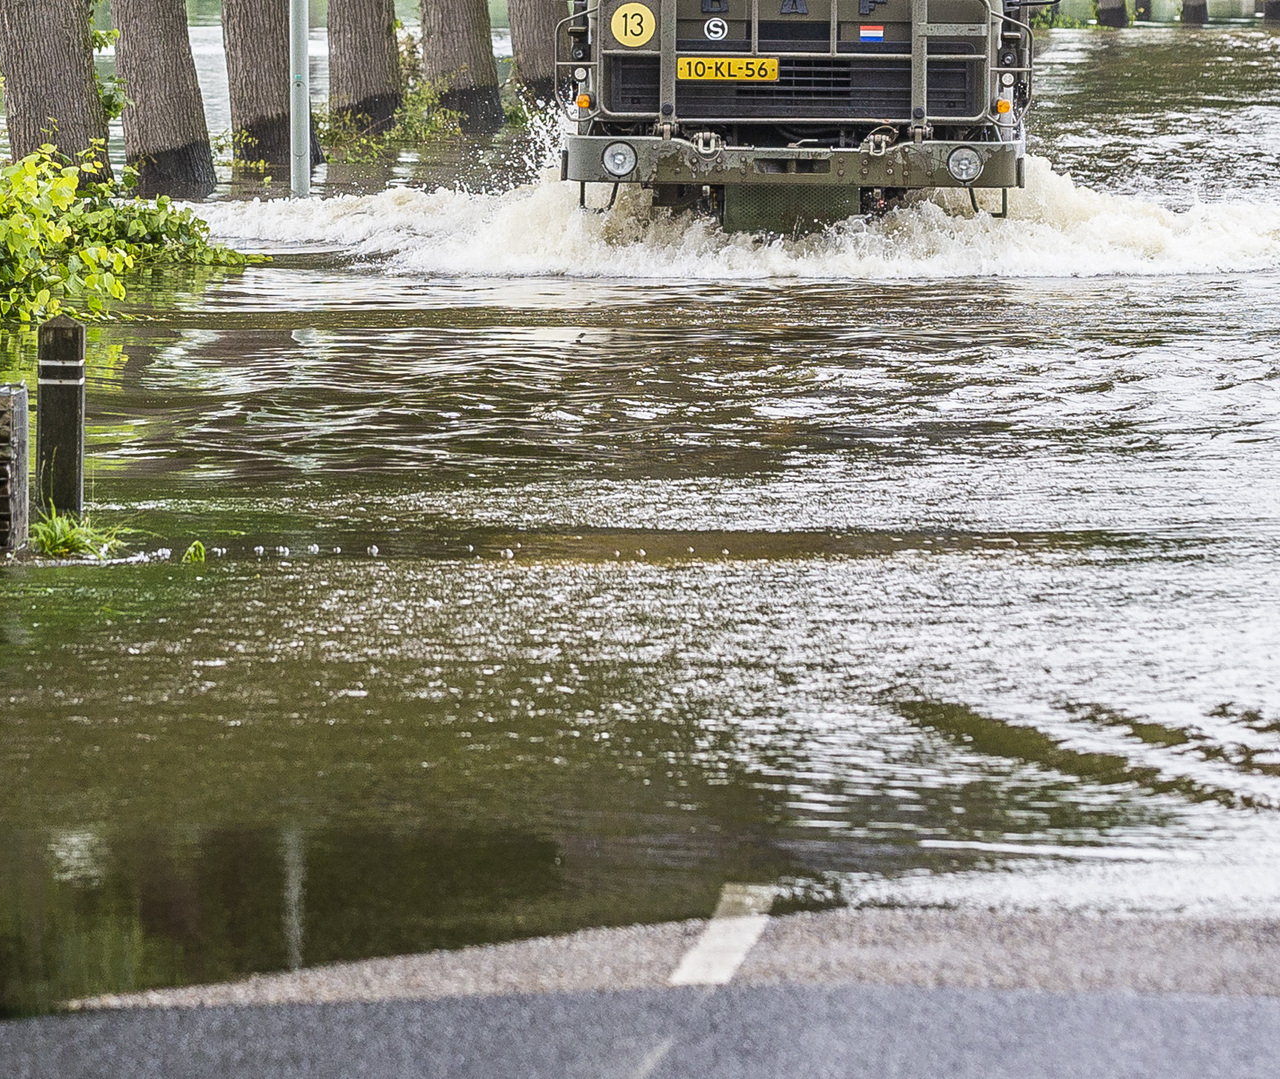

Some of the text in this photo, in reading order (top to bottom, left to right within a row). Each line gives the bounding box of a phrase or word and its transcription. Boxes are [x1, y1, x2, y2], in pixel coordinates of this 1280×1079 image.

[621, 12, 644, 37] 13
[708, 20, 724, 37] S
[686, 61, 768, 79] 10-KL-56
